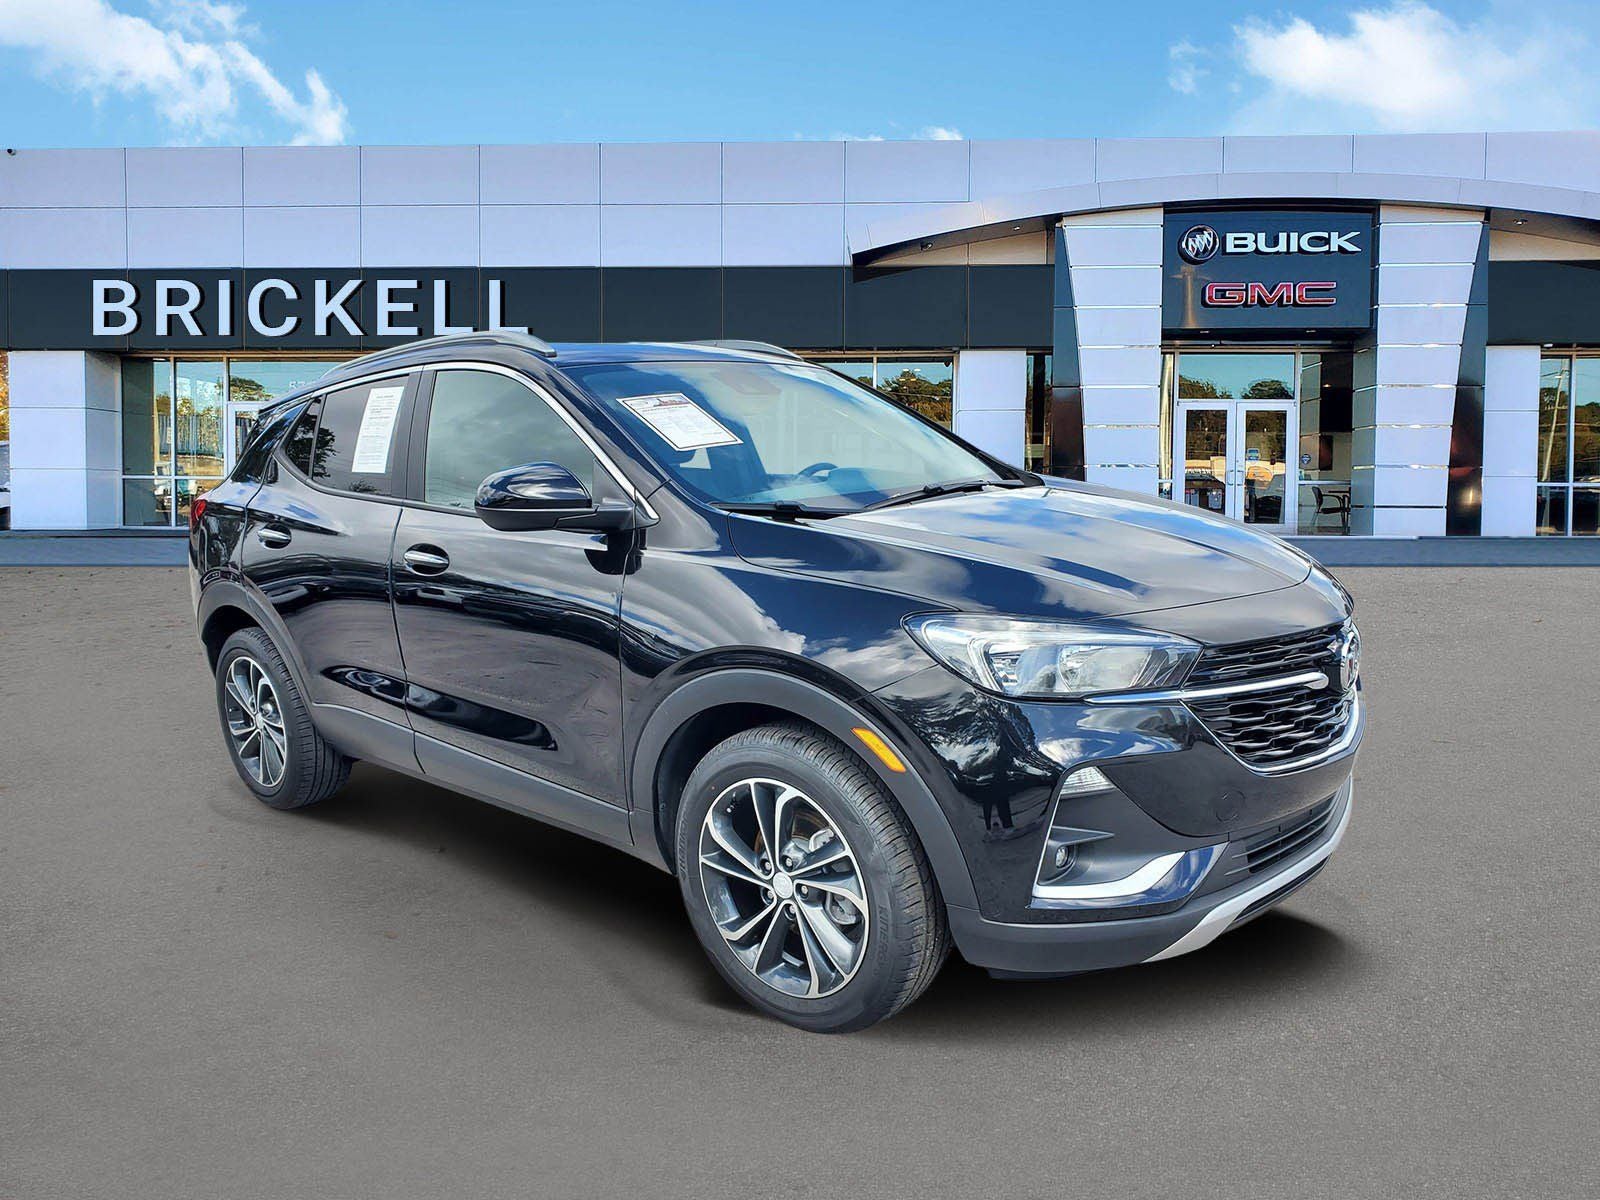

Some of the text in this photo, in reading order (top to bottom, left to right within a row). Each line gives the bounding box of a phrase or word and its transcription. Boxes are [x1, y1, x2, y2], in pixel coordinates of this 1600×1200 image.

[1226, 231, 1361, 253] BUICK
[1205, 281, 1337, 305] GMC
[92, 278, 530, 338] BRICKELL
